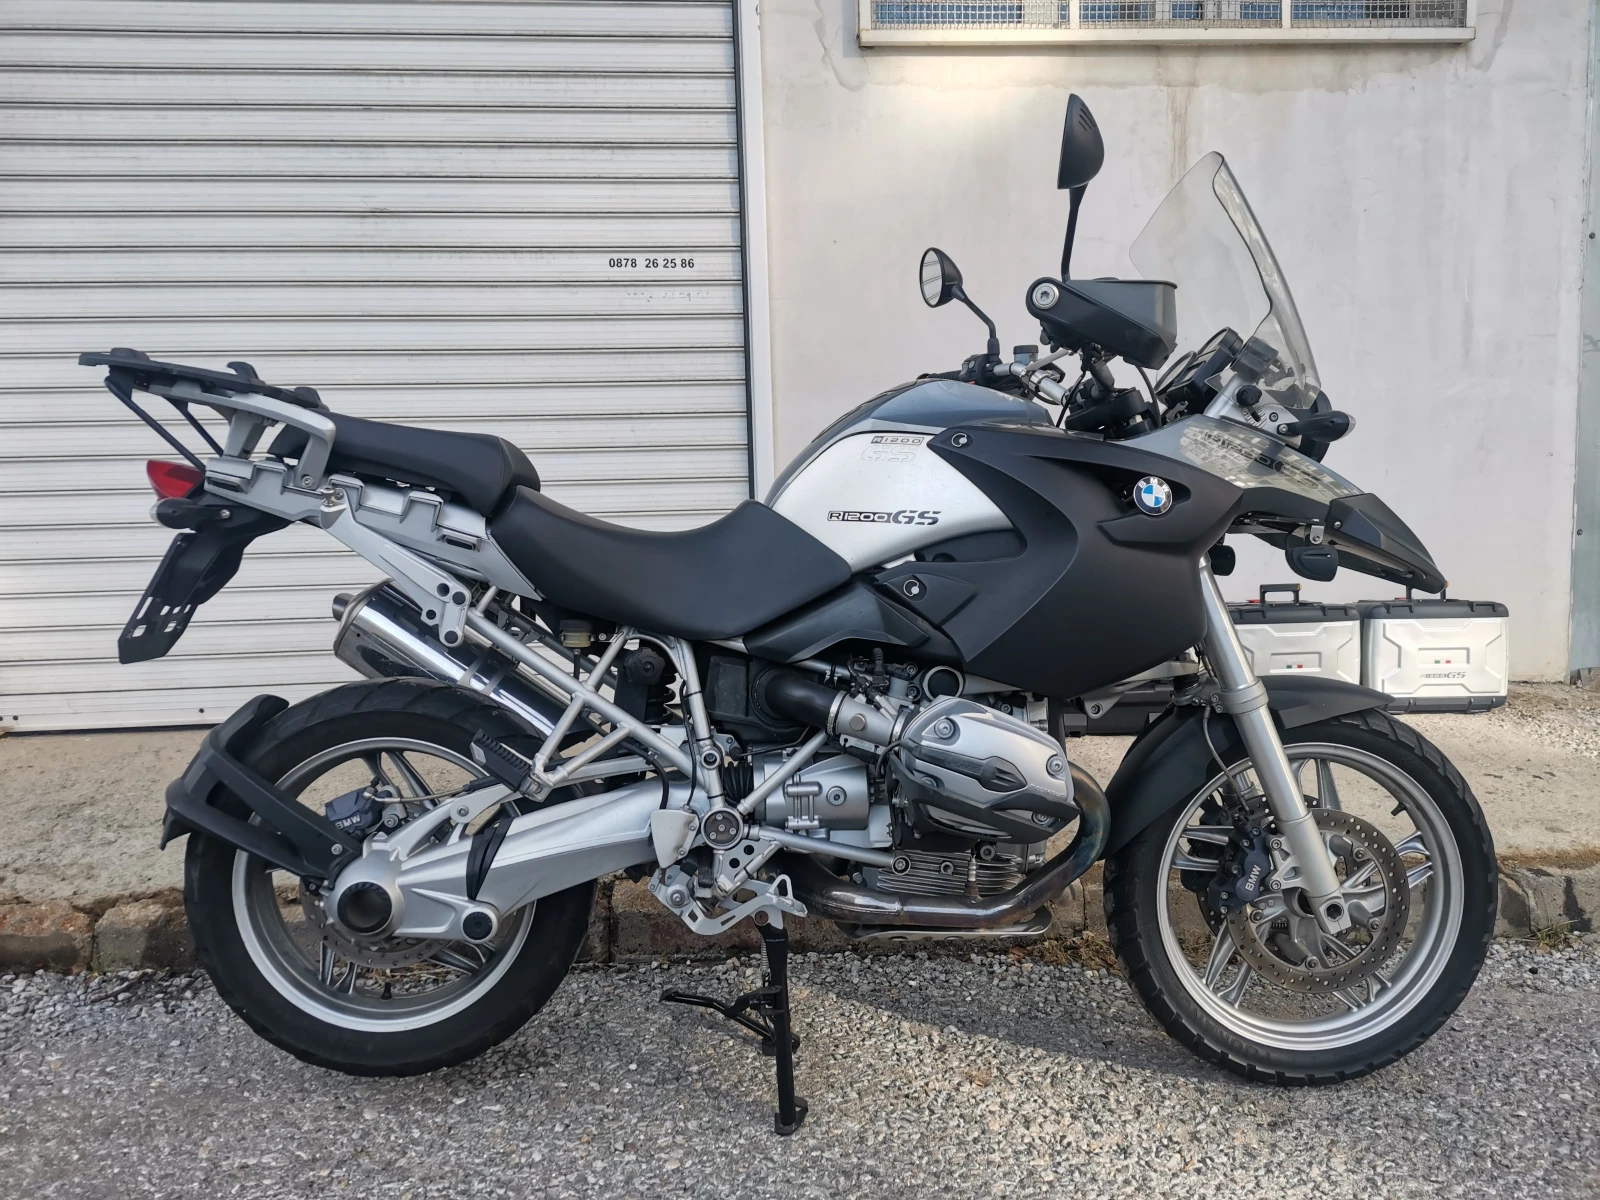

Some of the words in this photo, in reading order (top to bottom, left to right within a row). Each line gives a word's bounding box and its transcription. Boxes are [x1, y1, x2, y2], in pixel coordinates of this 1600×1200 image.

[608, 258, 637, 268] 0878
[644, 258, 659, 268] 26
[662, 258, 677, 268] 25
[680, 258, 695, 268] 86
[1138, 477, 1170, 492] BMW
[335, 814, 360, 829] BMW
[1245, 864, 1261, 891] BMW
